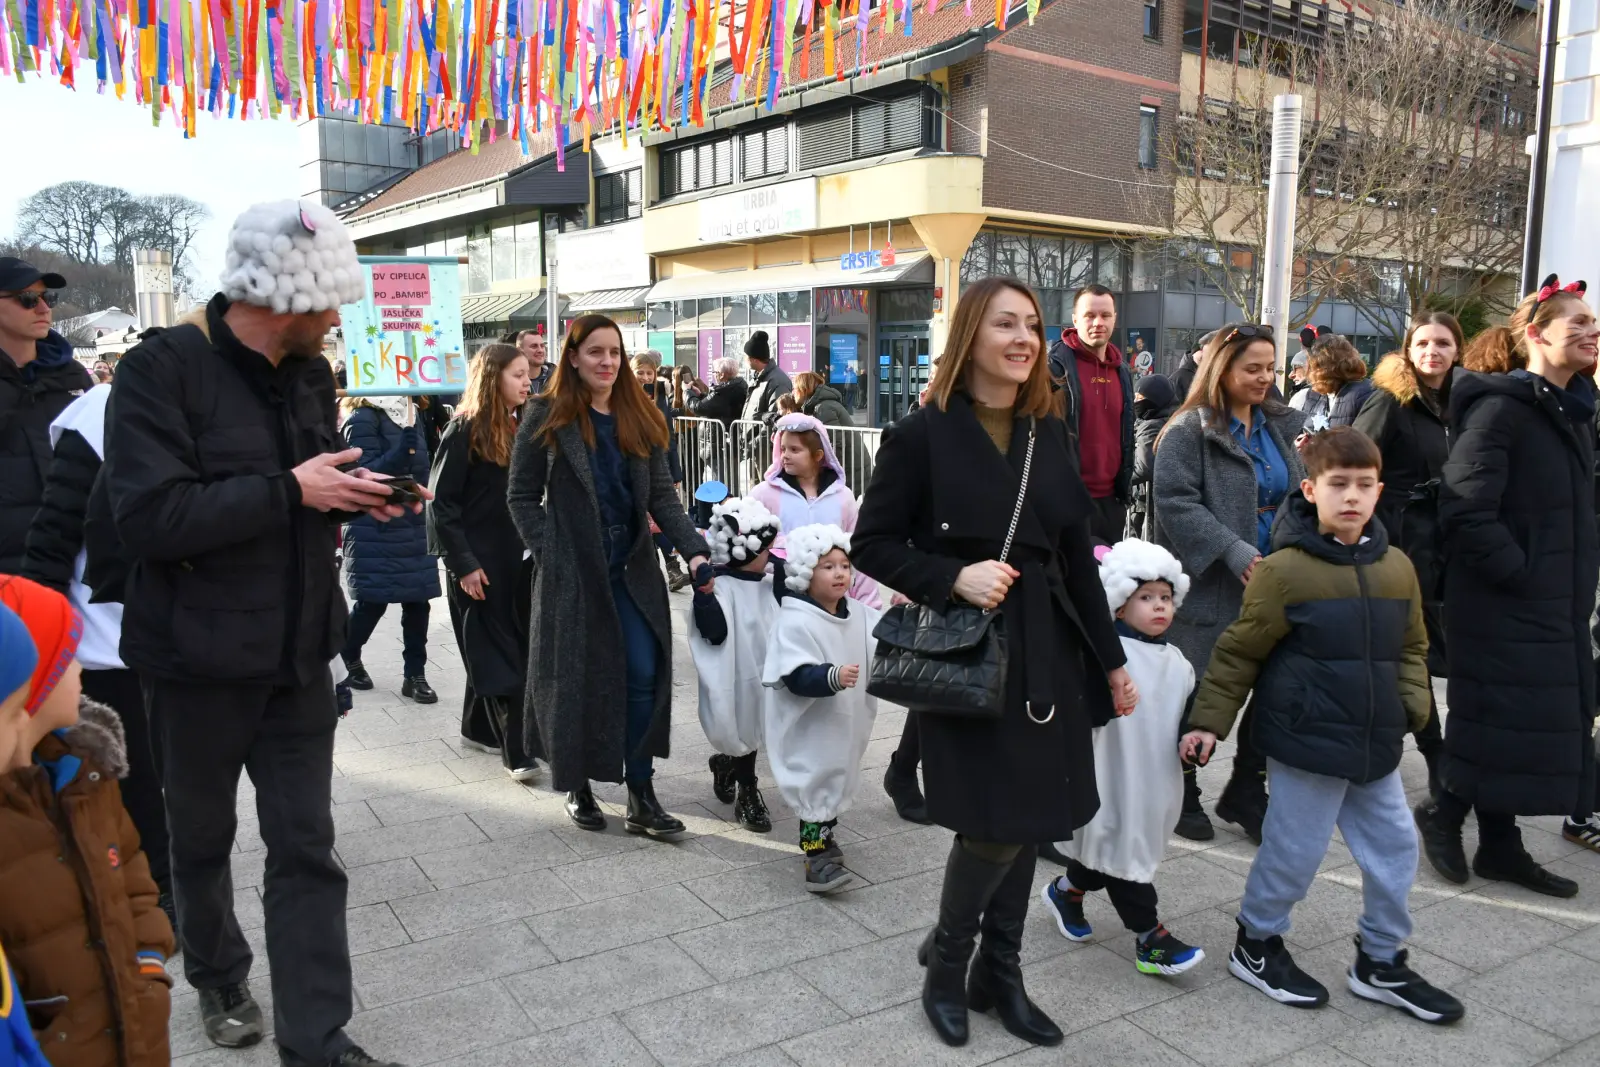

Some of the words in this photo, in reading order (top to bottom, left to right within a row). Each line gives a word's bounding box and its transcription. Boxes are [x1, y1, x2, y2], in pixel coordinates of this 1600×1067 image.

[743, 189, 777, 210] URBIA
[736, 217, 748, 234] et
[753, 214, 780, 233] orbi
[840, 249, 880, 271] ERSTE
[373, 273, 385, 281] DV
[390, 272, 426, 281] CIPELICA
[374, 291, 387, 299] PO
[383, 308, 422, 318] JASLIČKA
[382, 321, 421, 330] SKUPINA
